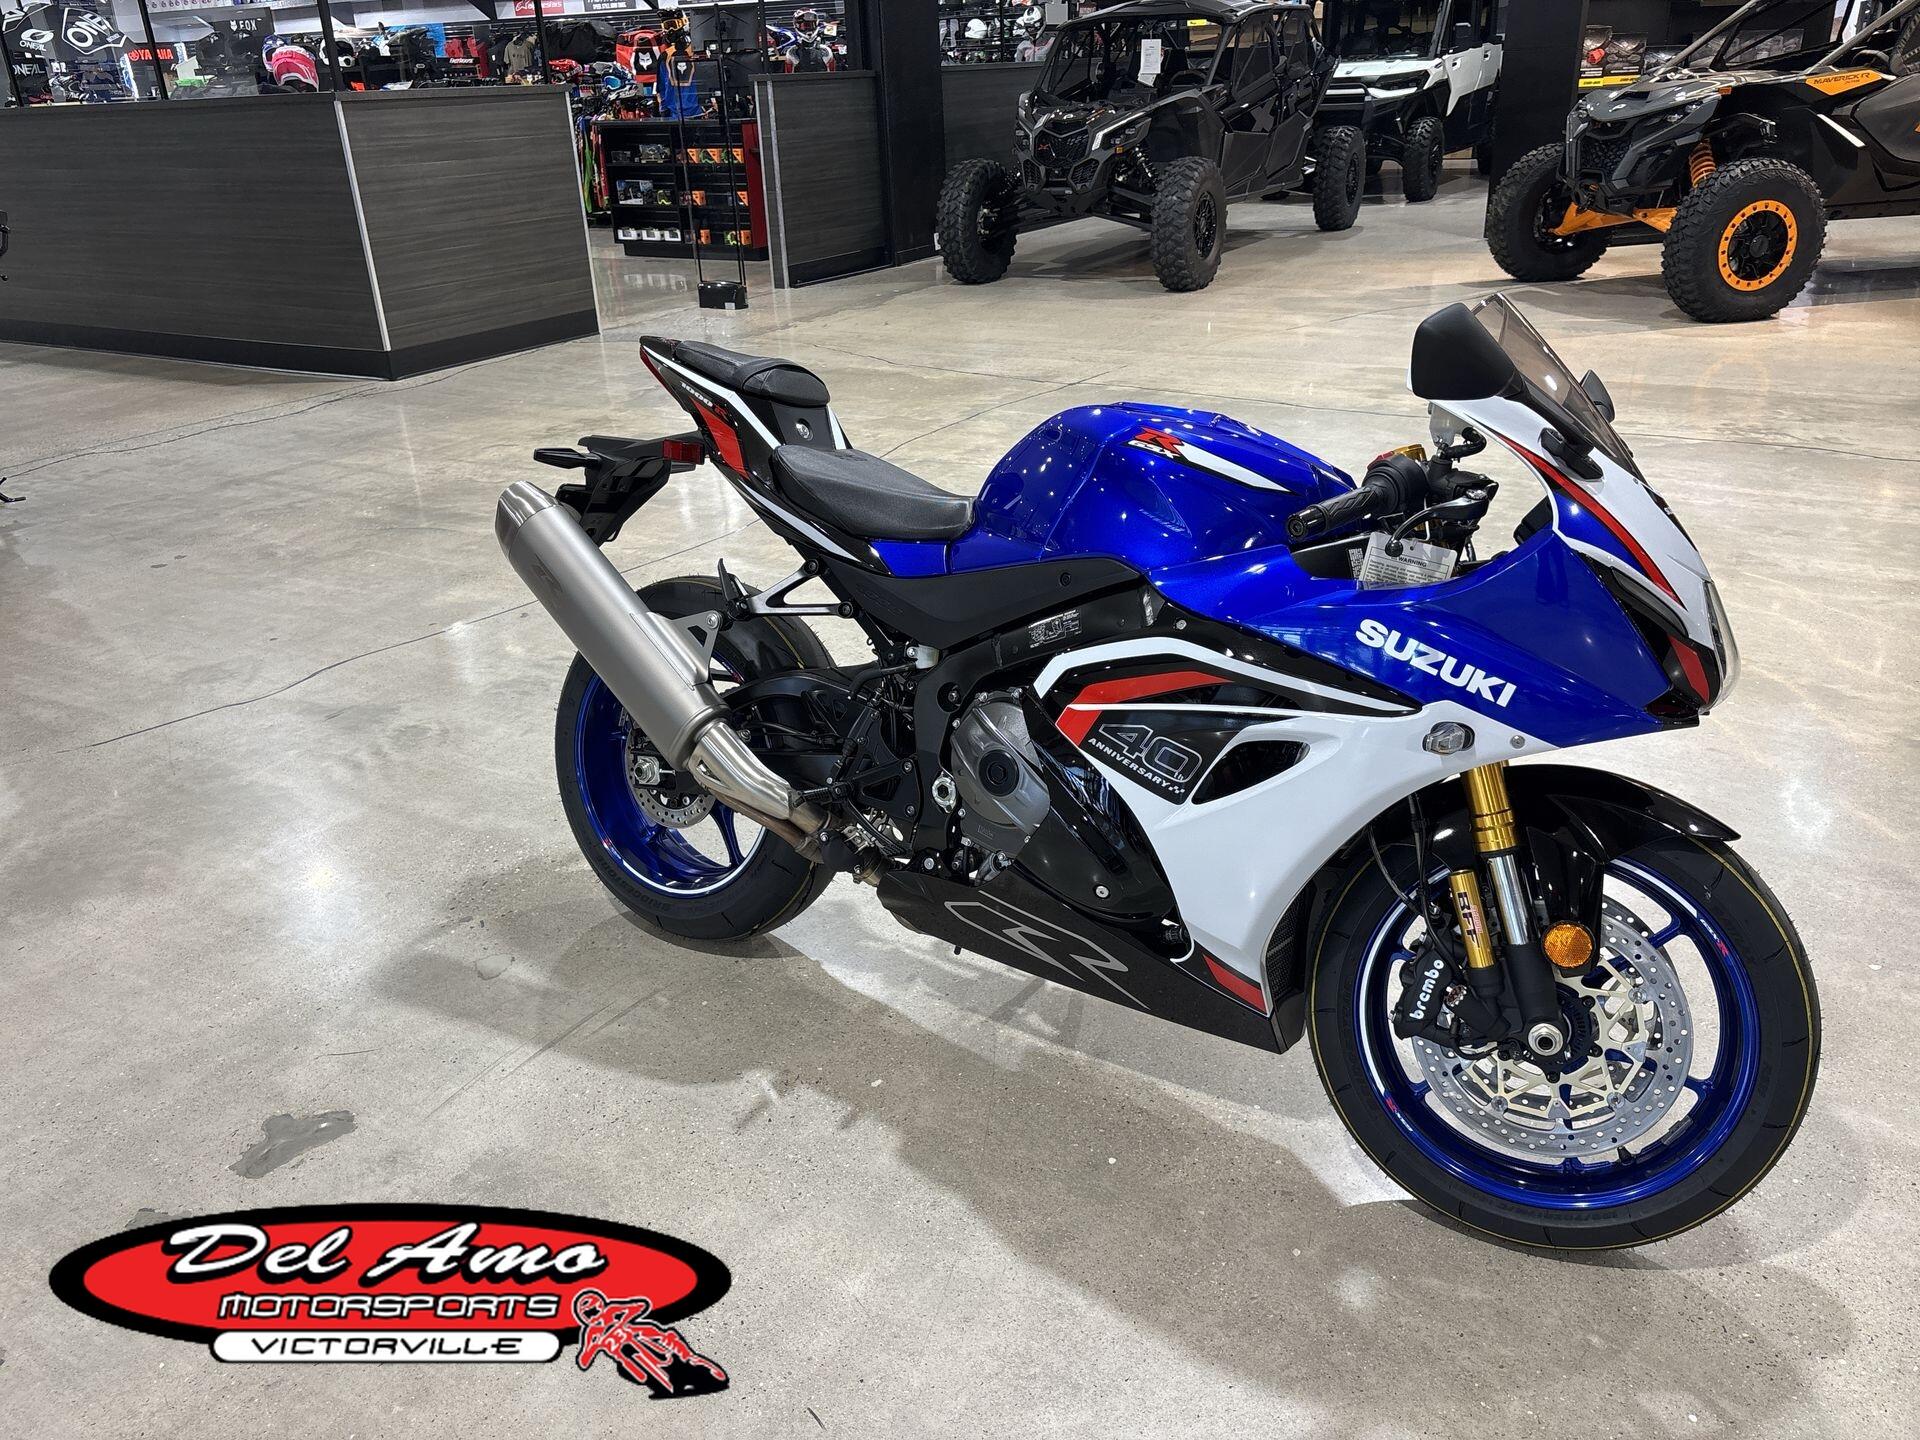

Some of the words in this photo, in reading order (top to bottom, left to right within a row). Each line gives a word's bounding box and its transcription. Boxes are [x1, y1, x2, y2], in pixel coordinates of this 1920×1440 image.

[239, 19, 257, 31] FOX
[138, 49, 174, 60] YAHA
[1814, 74, 1859, 84] MAVERICK
[1398, 556, 1427, 568] WARNING
[1355, 618, 1517, 708] SUZUKI
[1088, 737, 1171, 788] ANNIVERSARY
[1457, 891, 1481, 949] BFF
[1409, 959, 1445, 1020] brembo
